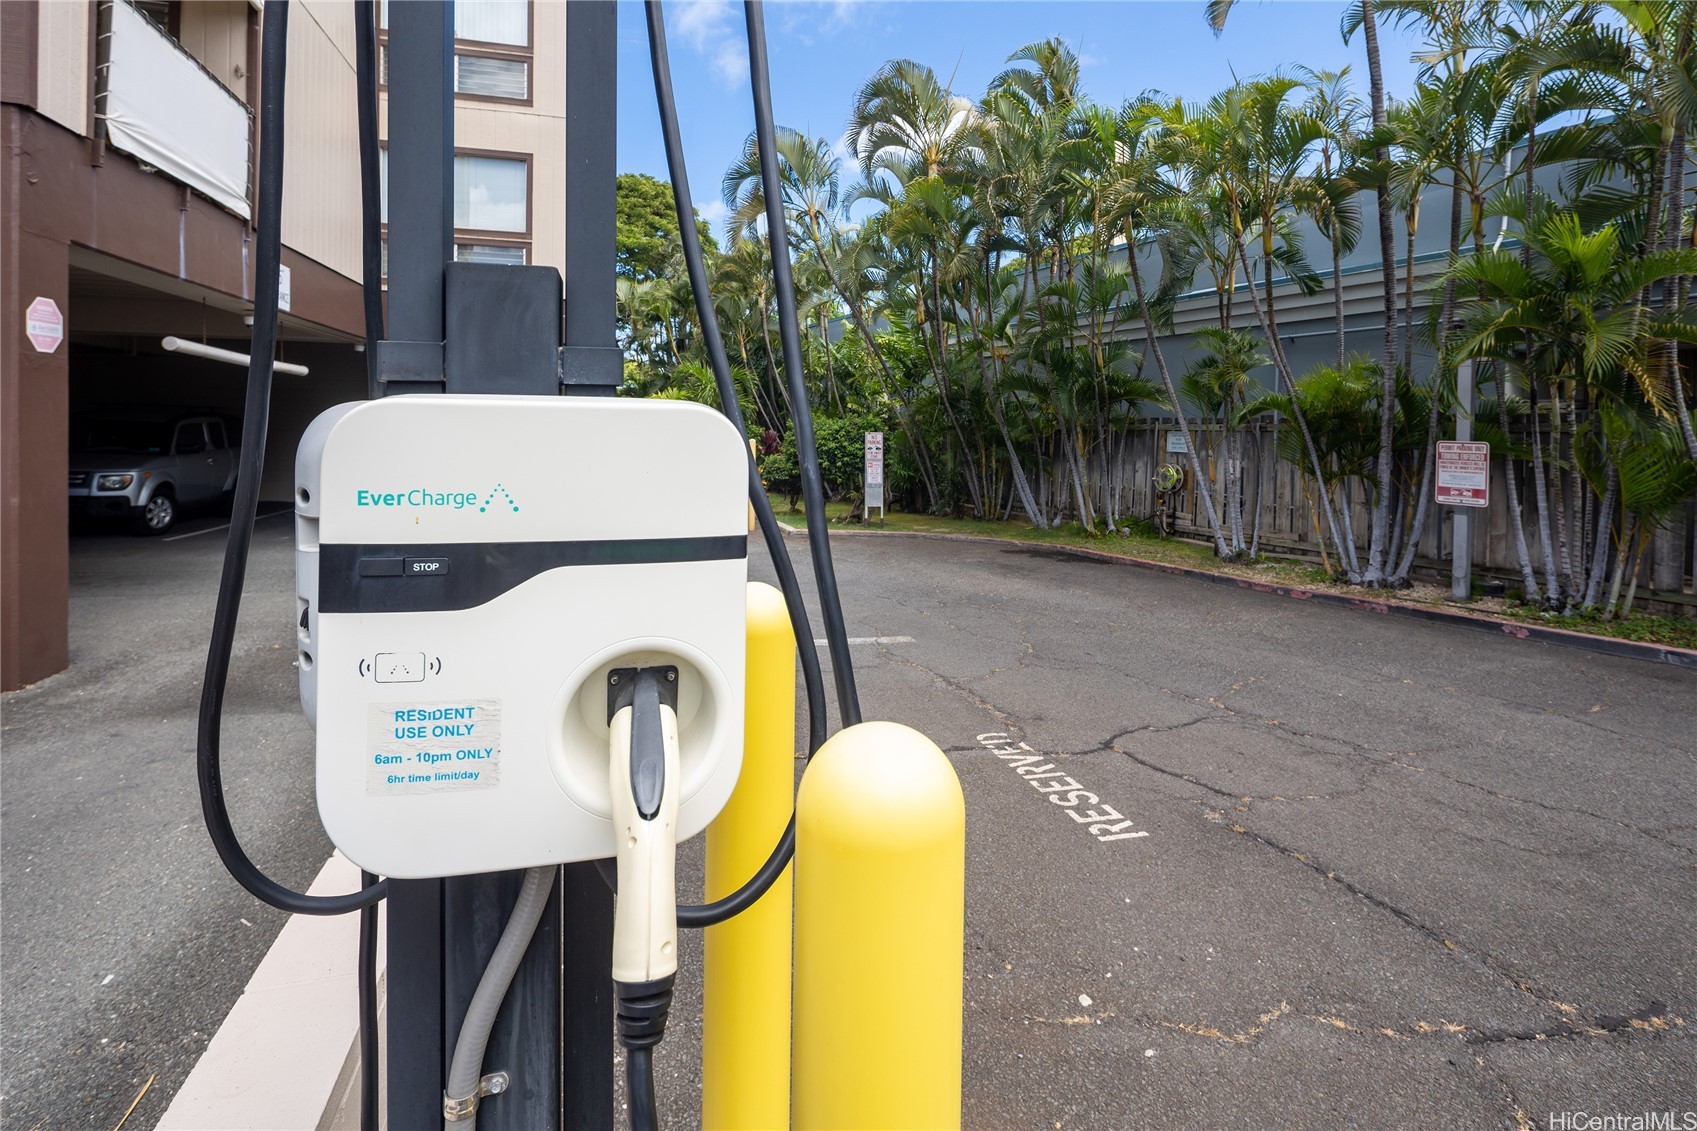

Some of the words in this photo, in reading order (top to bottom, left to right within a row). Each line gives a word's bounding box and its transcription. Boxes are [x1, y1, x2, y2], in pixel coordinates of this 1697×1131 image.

[1440, 452, 1459, 460] TOWING
[1460, 453, 1485, 461] ENFORCED
[413, 563, 439, 571] STOP
[395, 707, 475, 722] RESIDENT
[395, 726, 427, 739] USE
[432, 724, 474, 737] ONLY
[374, 754, 402, 764] 6am
[416, 752, 452, 764] 10pm
[456, 748, 493, 760] ONLY
[387, 775, 405, 783] 6hr
[408, 774, 431, 783] time
[434, 771, 480, 781] limit/day
[976, 732, 1150, 842] RESERVED
